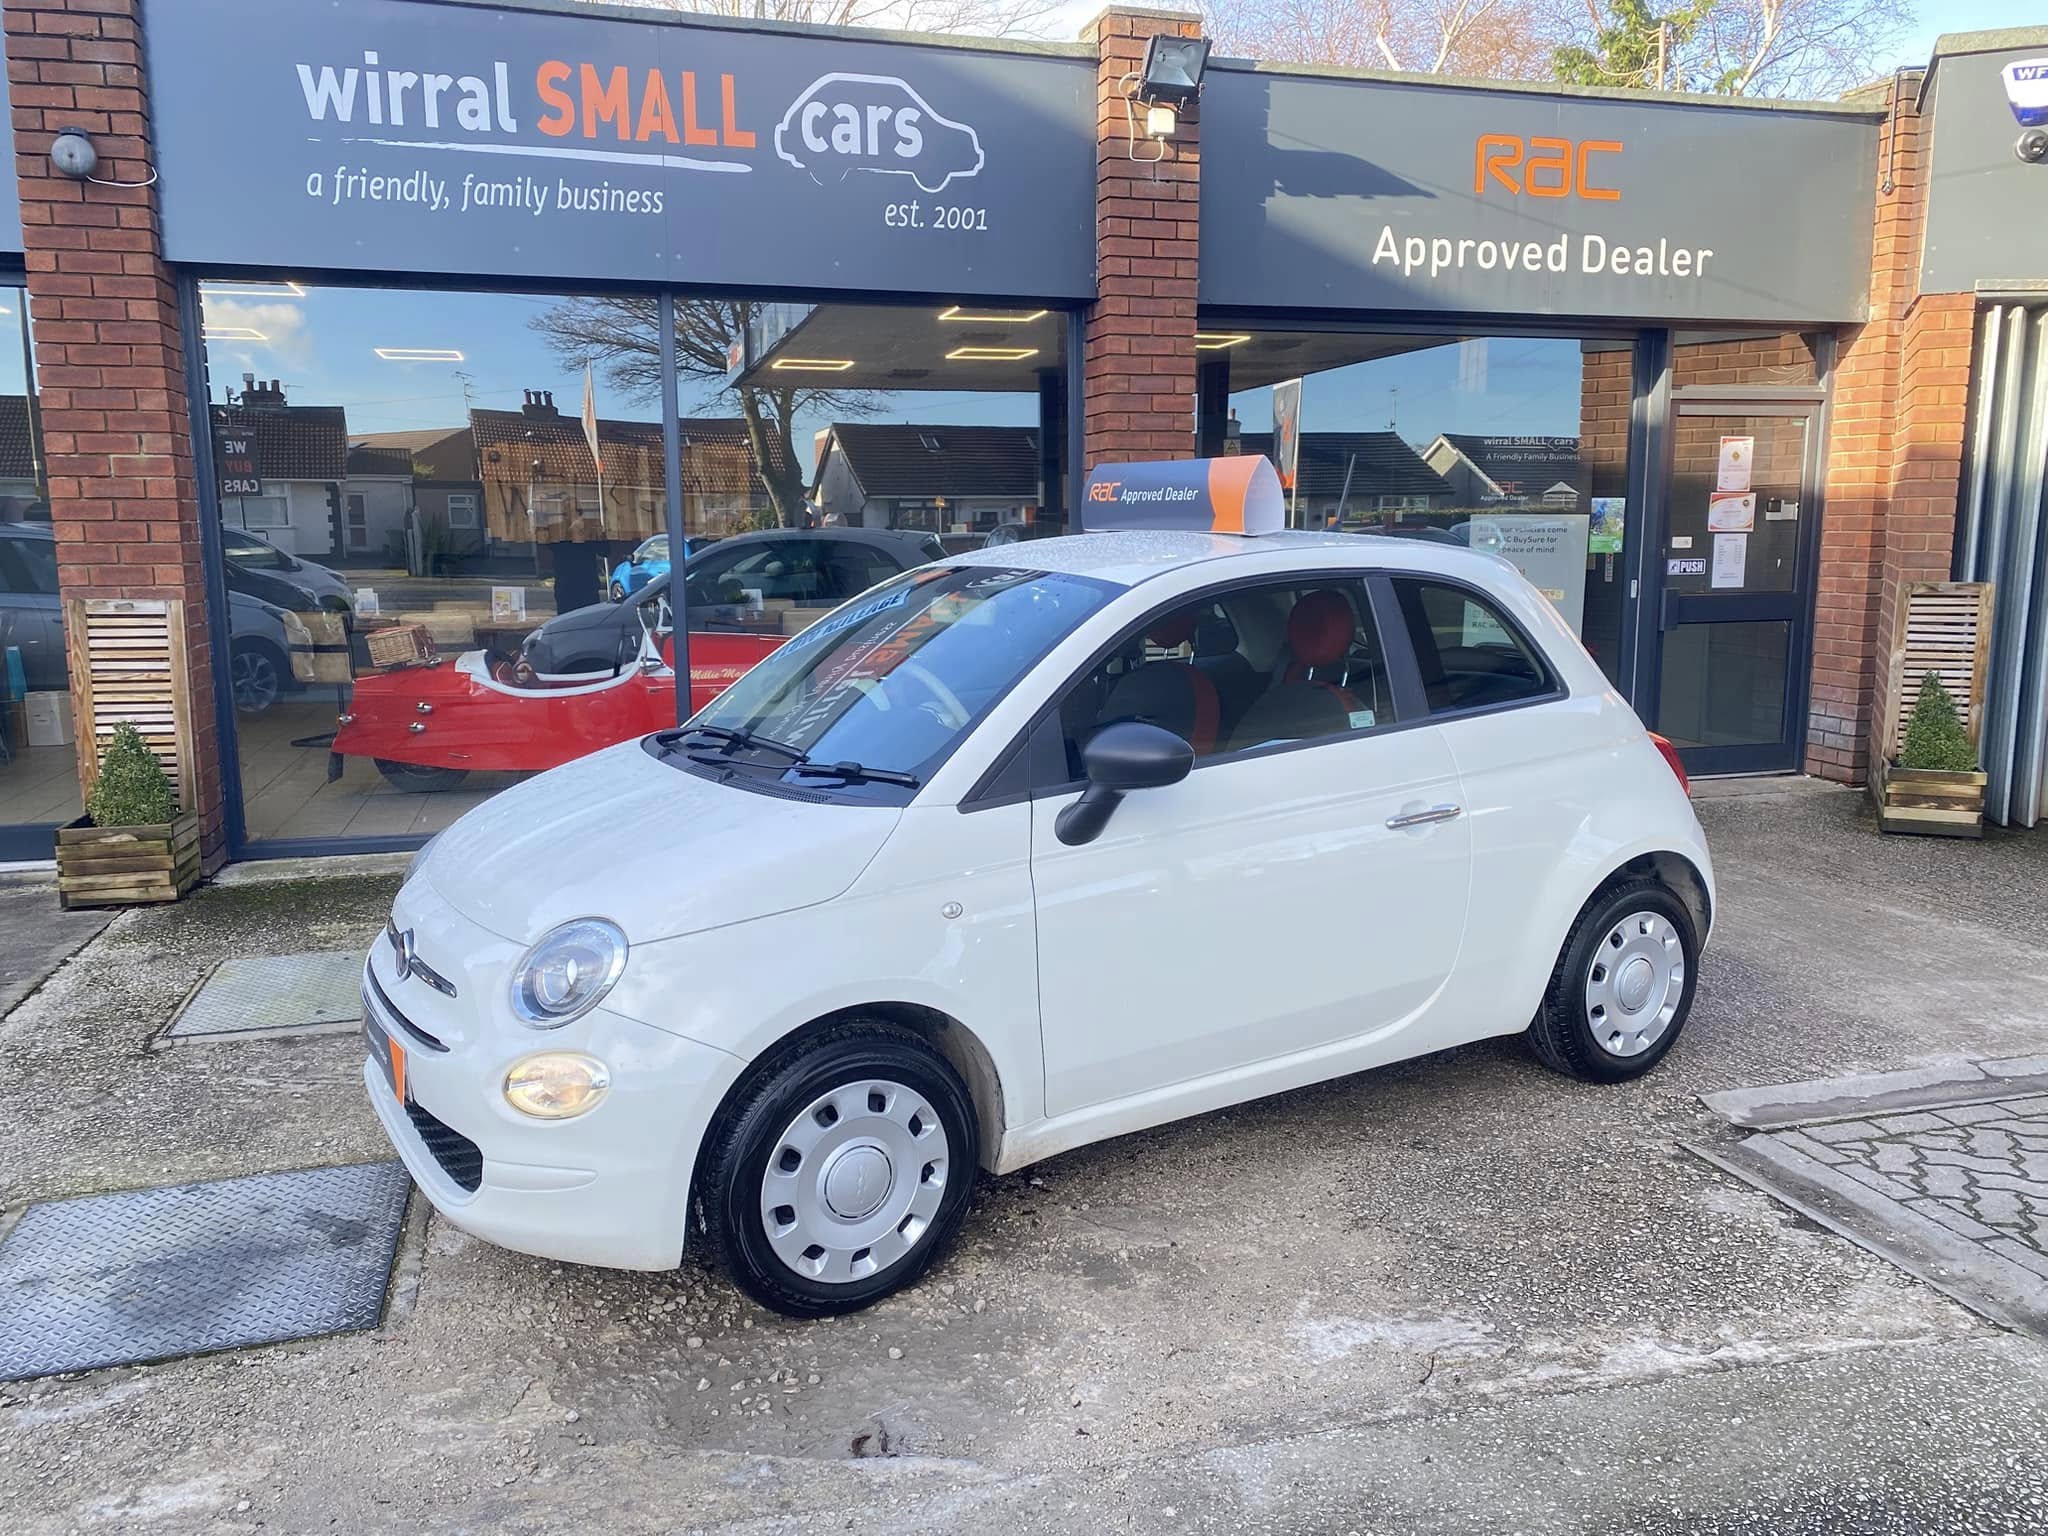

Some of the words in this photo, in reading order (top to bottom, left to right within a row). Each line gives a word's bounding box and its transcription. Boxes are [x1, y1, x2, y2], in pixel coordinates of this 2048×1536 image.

[296, 51, 517, 133] wirral
[536, 60, 757, 149] SMALL
[801, 101, 924, 158] cars
[305, 172, 322, 197] a
[333, 166, 450, 211] friendly,
[460, 176, 548, 216] family
[556, 185, 664, 214] business
[884, 200, 925, 228] est.
[933, 206, 988, 231] 2001
[1372, 225, 1569, 278] Approved
[1582, 234, 1715, 278] Dealer
[1483, 436, 1512, 446] wirral
[1513, 436, 1547, 446] SMALL
[1554, 437, 1574, 446] cars
[1120, 488, 1164, 504] Approved
[1165, 487, 1198, 501] Dealer
[1547, 535, 1558, 544] for
[1526, 545, 1534, 553] of
[1535, 545, 1555, 553] mind
[1680, 561, 1704, 573] PUSH
